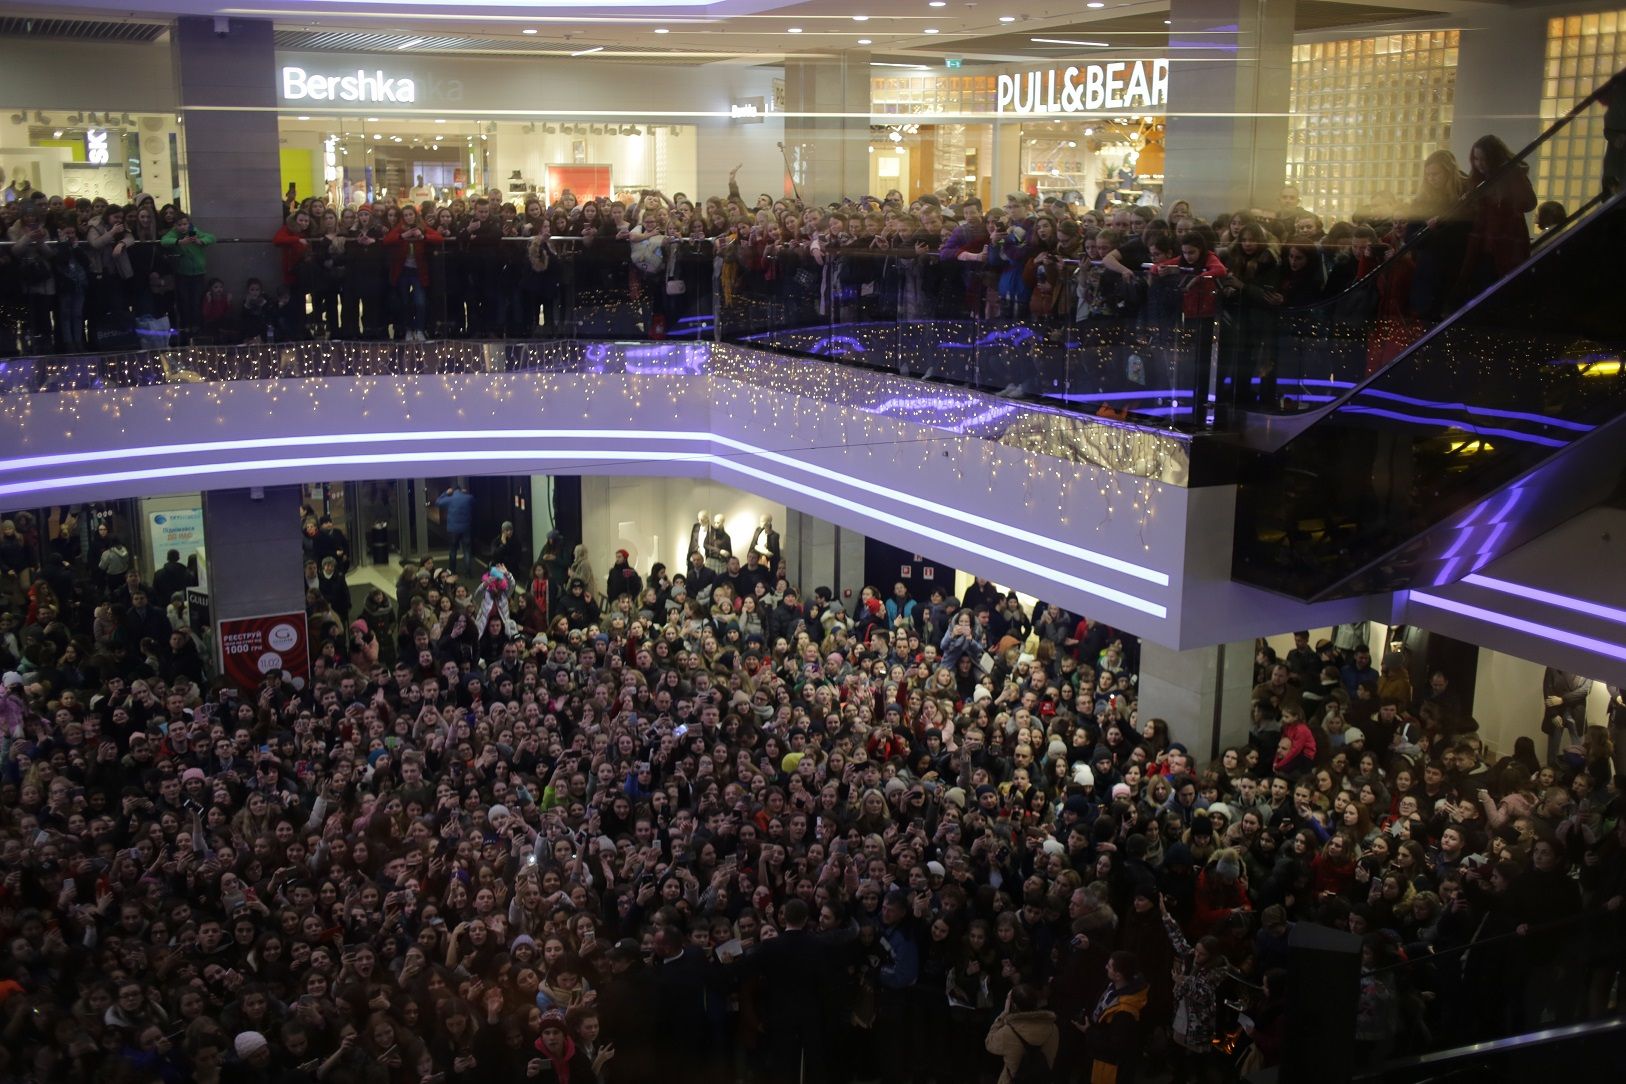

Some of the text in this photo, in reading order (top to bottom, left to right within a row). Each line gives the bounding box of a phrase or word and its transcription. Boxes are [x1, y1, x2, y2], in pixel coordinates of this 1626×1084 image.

[282, 66, 415, 103] Bershka
[997, 59, 1169, 115] PULL&BEAR
[225, 644, 249, 655] 1000
